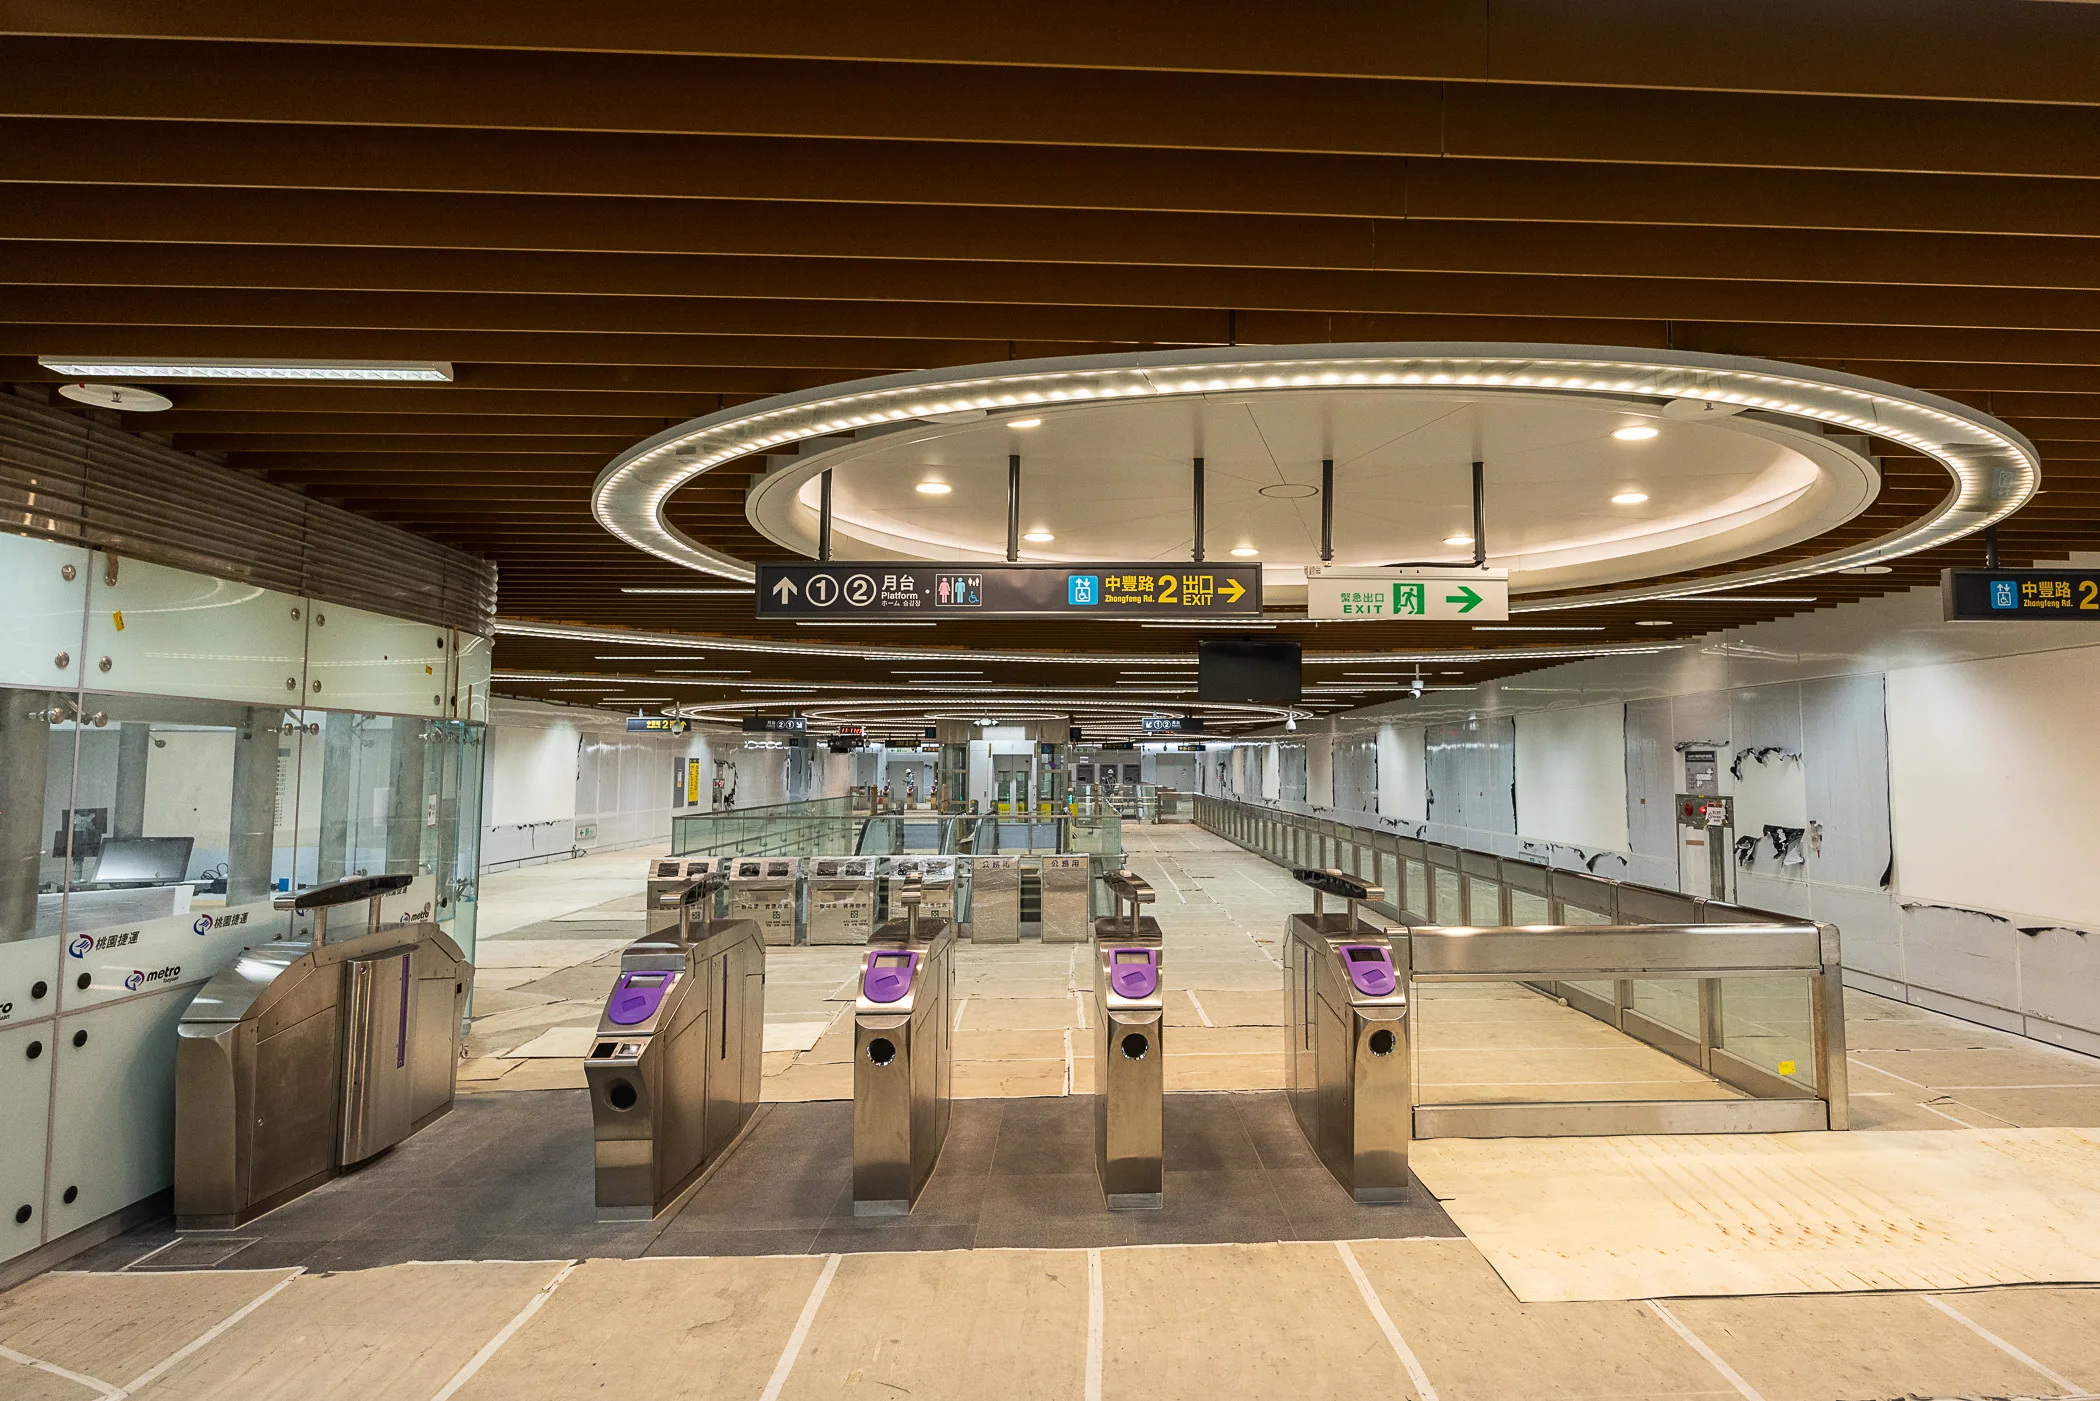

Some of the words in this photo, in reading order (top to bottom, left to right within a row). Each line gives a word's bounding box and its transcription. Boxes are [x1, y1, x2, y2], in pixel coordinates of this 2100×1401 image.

[881, 574, 915, 591] 月台
[1105, 575, 1154, 592] 中豐路
[1158, 575, 1178, 603] 2
[1182, 575, 1214, 595] 出口
[2022, 581, 2071, 598] 中豐路
[2078, 580, 2100, 610] 2
[881, 591, 918, 600] Platform
[1105, 595, 1141, 604] Zhongfeng
[1143, 595, 1155, 603] Rd.
[1183, 594, 1214, 606] EXIT
[1341, 592, 1385, 603] 緊急出口
[1343, 604, 1383, 614] EXIT
[2023, 599, 2060, 609] Zhongfeng
[2061, 599, 2074, 607] Rd.
[1051, 859, 1080, 868] 公務用
[214, 912, 249, 929] 桃園捷運
[95, 931, 140, 951] 桃園捷運
[146, 966, 181, 982] metro
